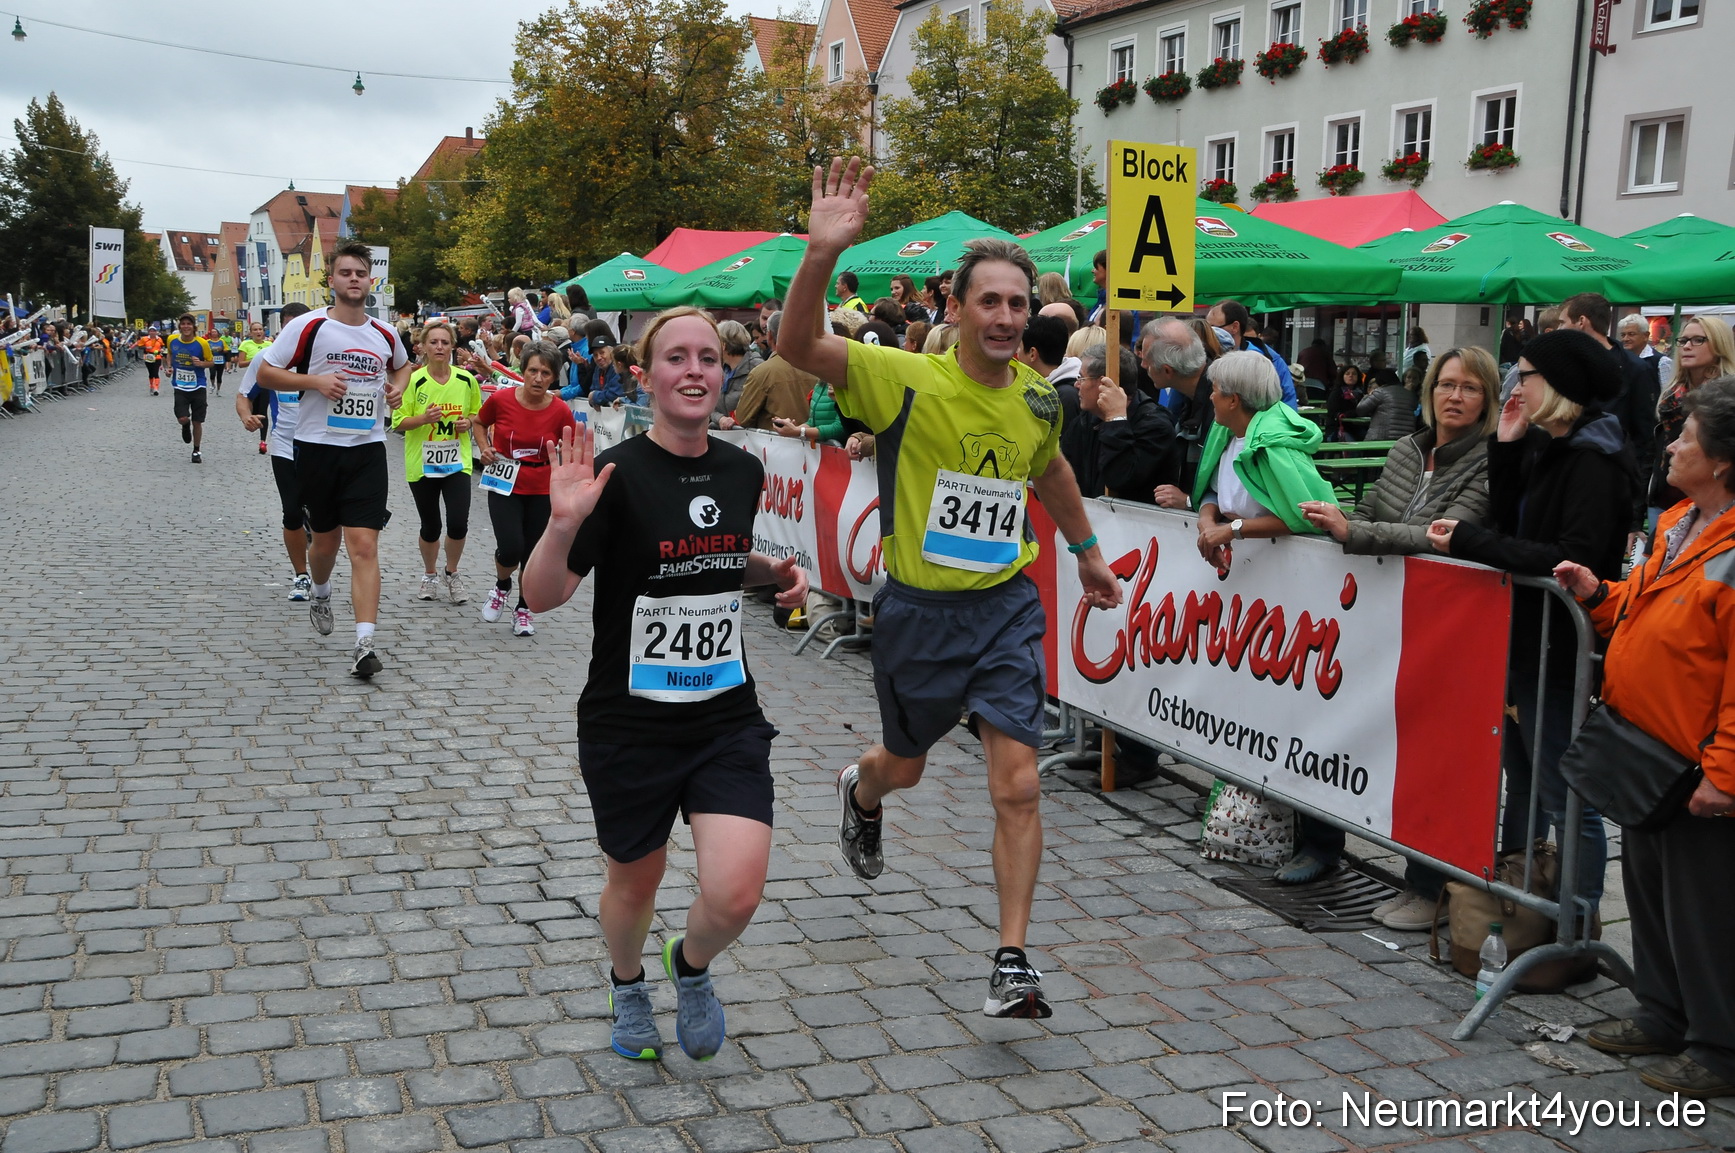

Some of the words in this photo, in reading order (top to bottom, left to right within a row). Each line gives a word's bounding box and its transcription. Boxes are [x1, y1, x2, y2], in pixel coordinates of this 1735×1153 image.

[1123, 148, 1187, 183] Block
[1129, 195, 1177, 275] A
[95, 241, 121, 251] swn
[845, 265, 942, 273] Lammsbräu
[326, 353, 374, 365] GERHART
[177, 373, 195, 381] 3412
[333, 398, 374, 416] 3359
[439, 403, 462, 411] üller
[436, 421, 453, 435] M
[427, 449, 458, 463] 2072
[937, 479, 971, 494] PARTL
[973, 486, 1014, 499] Neumarkt
[939, 495, 1018, 537] 3414
[636, 606, 675, 617] PARTL
[679, 604, 727, 616] Neumarkt
[1071, 536, 1358, 700] Charivari
[644, 619, 733, 661] 2482
[667, 671, 713, 687] Nicole
[1148, 687, 1279, 762] Ostbayerns
[1285, 735, 1369, 796] Radio
